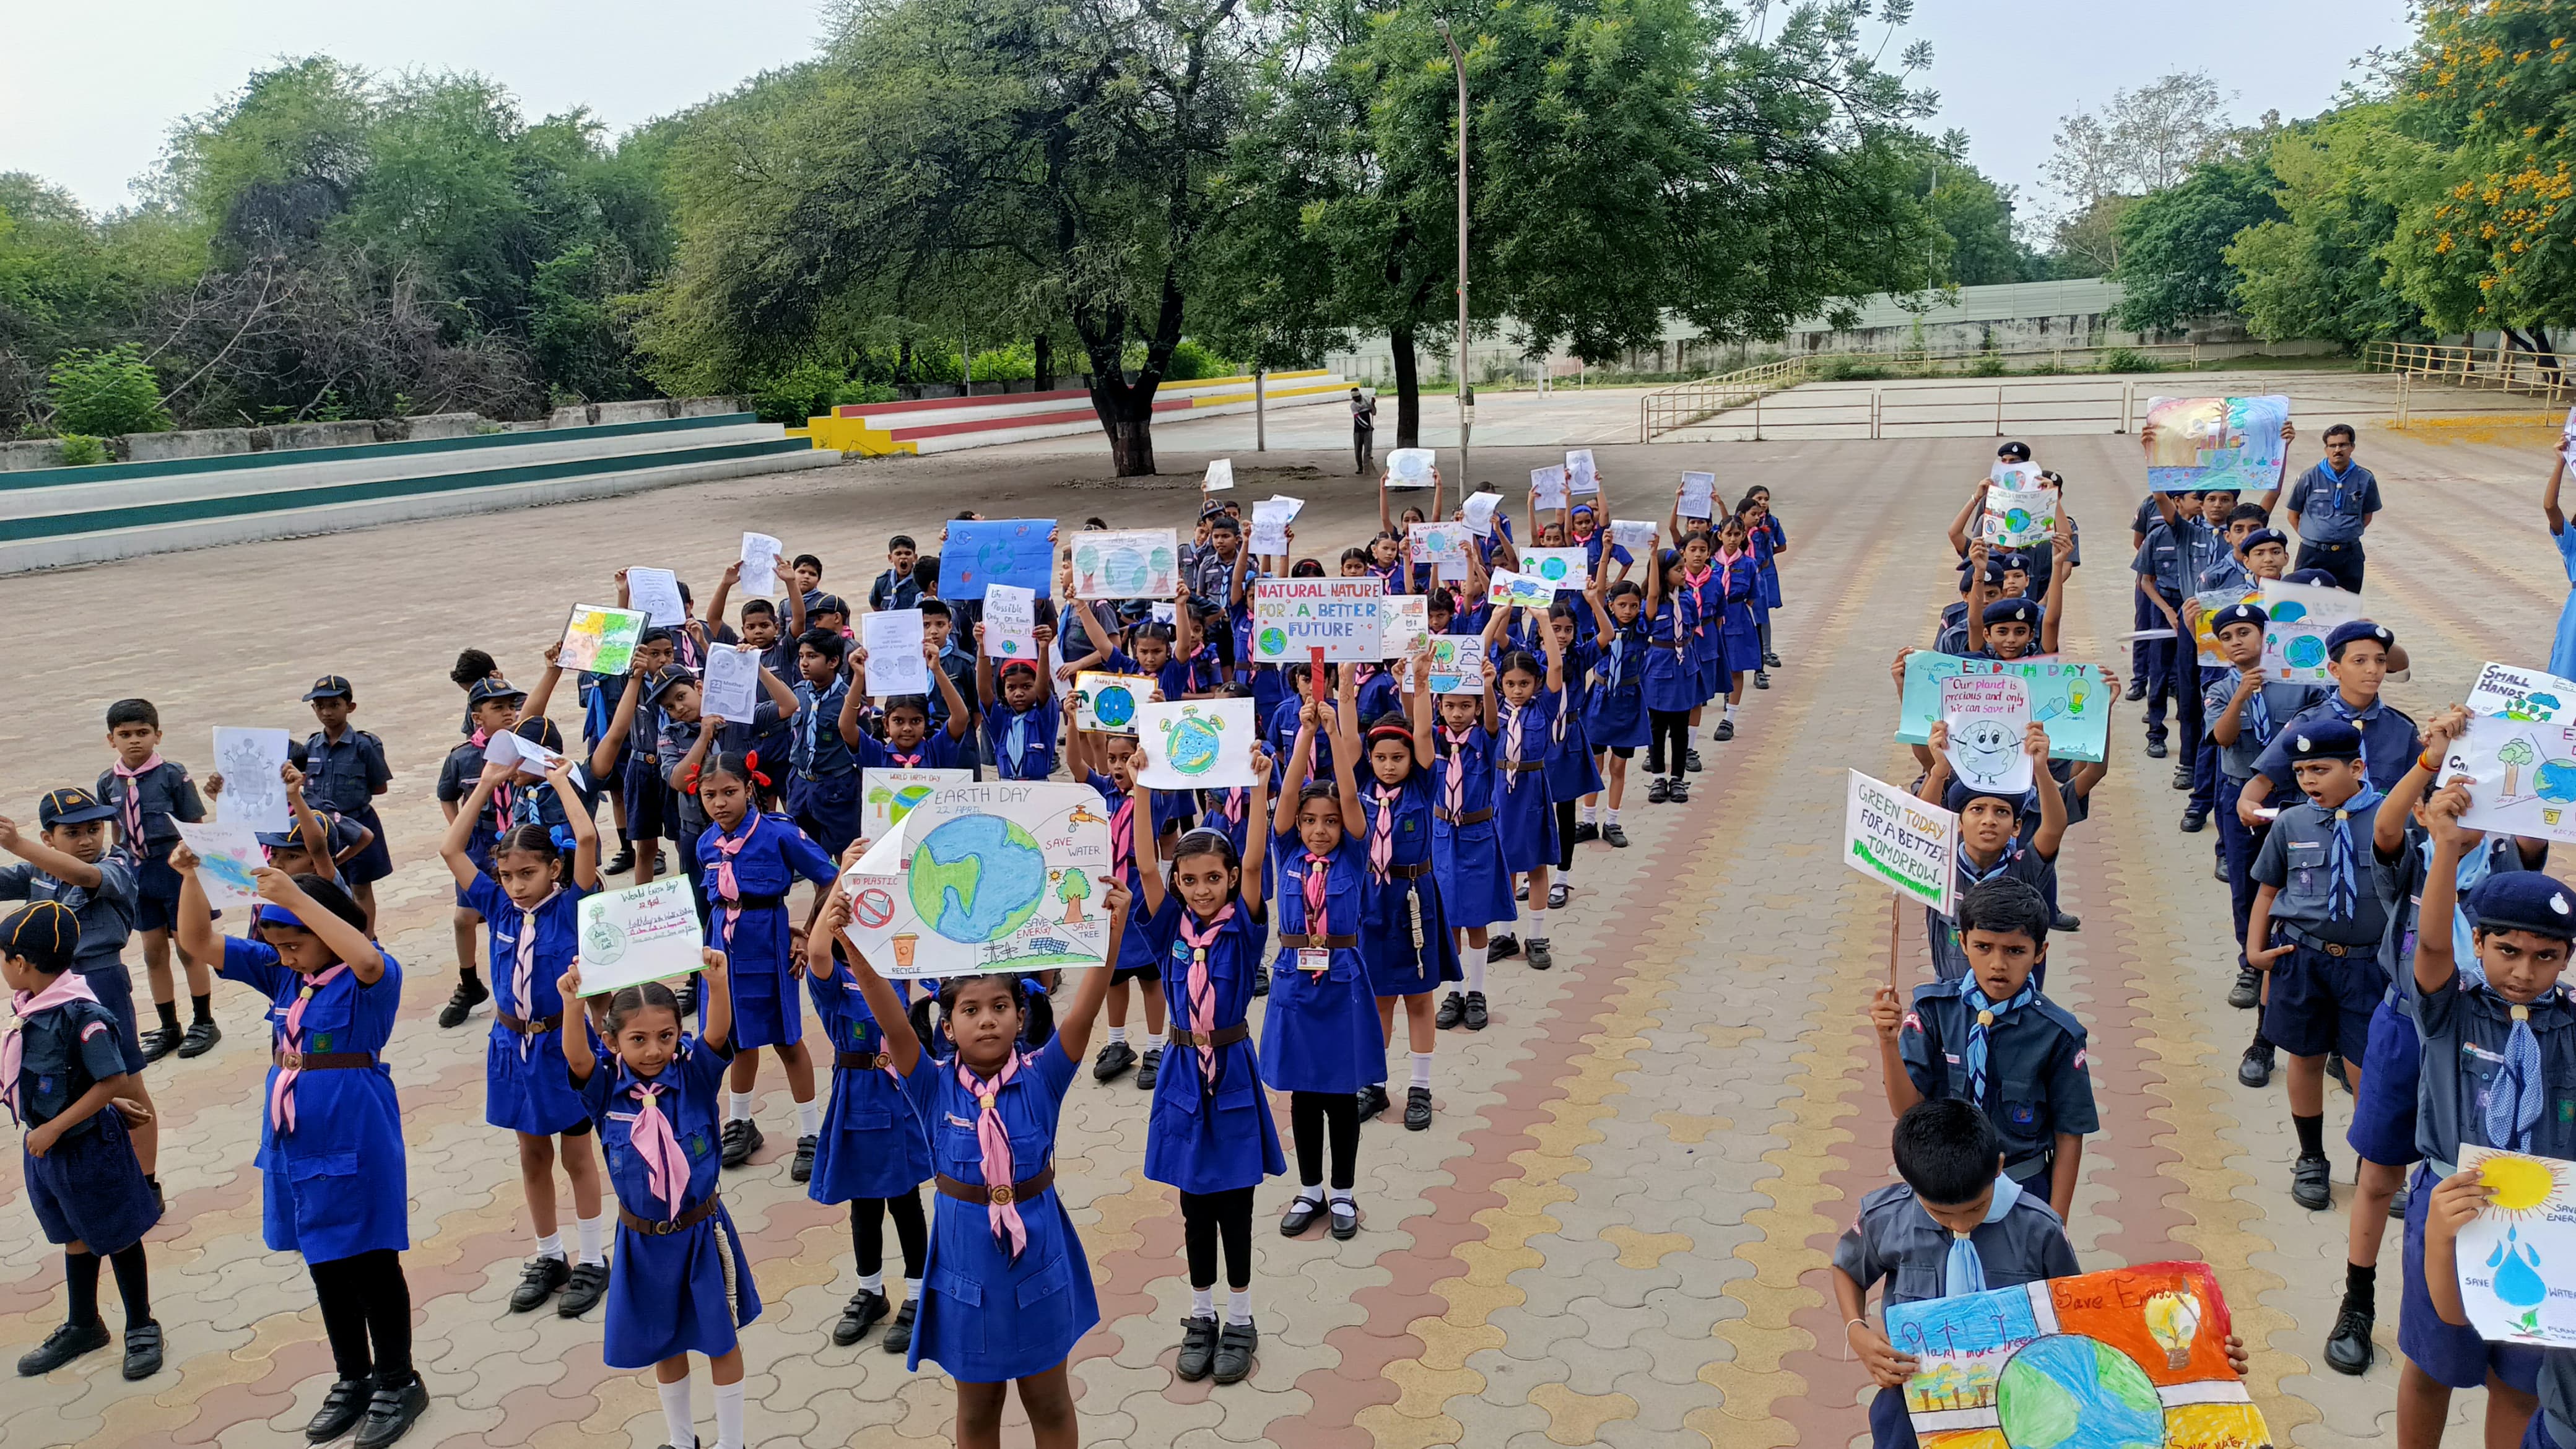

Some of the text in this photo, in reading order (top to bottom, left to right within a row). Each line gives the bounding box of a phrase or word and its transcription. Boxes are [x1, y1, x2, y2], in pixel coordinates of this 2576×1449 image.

[1258, 583, 1380, 598] NATURAL NATURE
[1258, 603, 1286, 617] FOR
[1297, 603, 1311, 617] A
[1318, 603, 1377, 617] BETTER
[1289, 622, 1354, 637] FUTURE
[1962, 660, 2086, 677] EARTH DAY
[2483, 665, 2531, 689] SMALL
[1975, 679, 2006, 691] planet
[2010, 680, 2017, 690] is
[2478, 679, 2526, 700] HANDS
[1945, 691, 2024, 706] precious and only
[1965, 704, 1980, 713] can
[1982, 705, 2003, 713] save
[929, 774, 941, 782] DAY
[935, 786, 1032, 804] EARTH DAY
[936, 806, 983, 814] 22 APRIL
[1858, 784, 1947, 840] GREEN TODAY
[1046, 837, 1073, 850] SAVE
[1860, 809, 1950, 866] FOR A BETTER
[1068, 846, 1101, 857] WATER
[1868, 834, 1942, 886] TOMORROW.
[853, 877, 898, 886] NO PLASTIC
[1025, 918, 1048, 928] SAVE
[1073, 922, 1095, 931] SAVE
[1017, 925, 1052, 939] ENERGY
[1079, 930, 1100, 939] TREE
[892, 967, 921, 975] RECYCLE
[2546, 1212, 2576, 1224] ENER
[2055, 1282, 2103, 1310] Save
[1901, 1313, 2034, 1360] Plant more Trees
